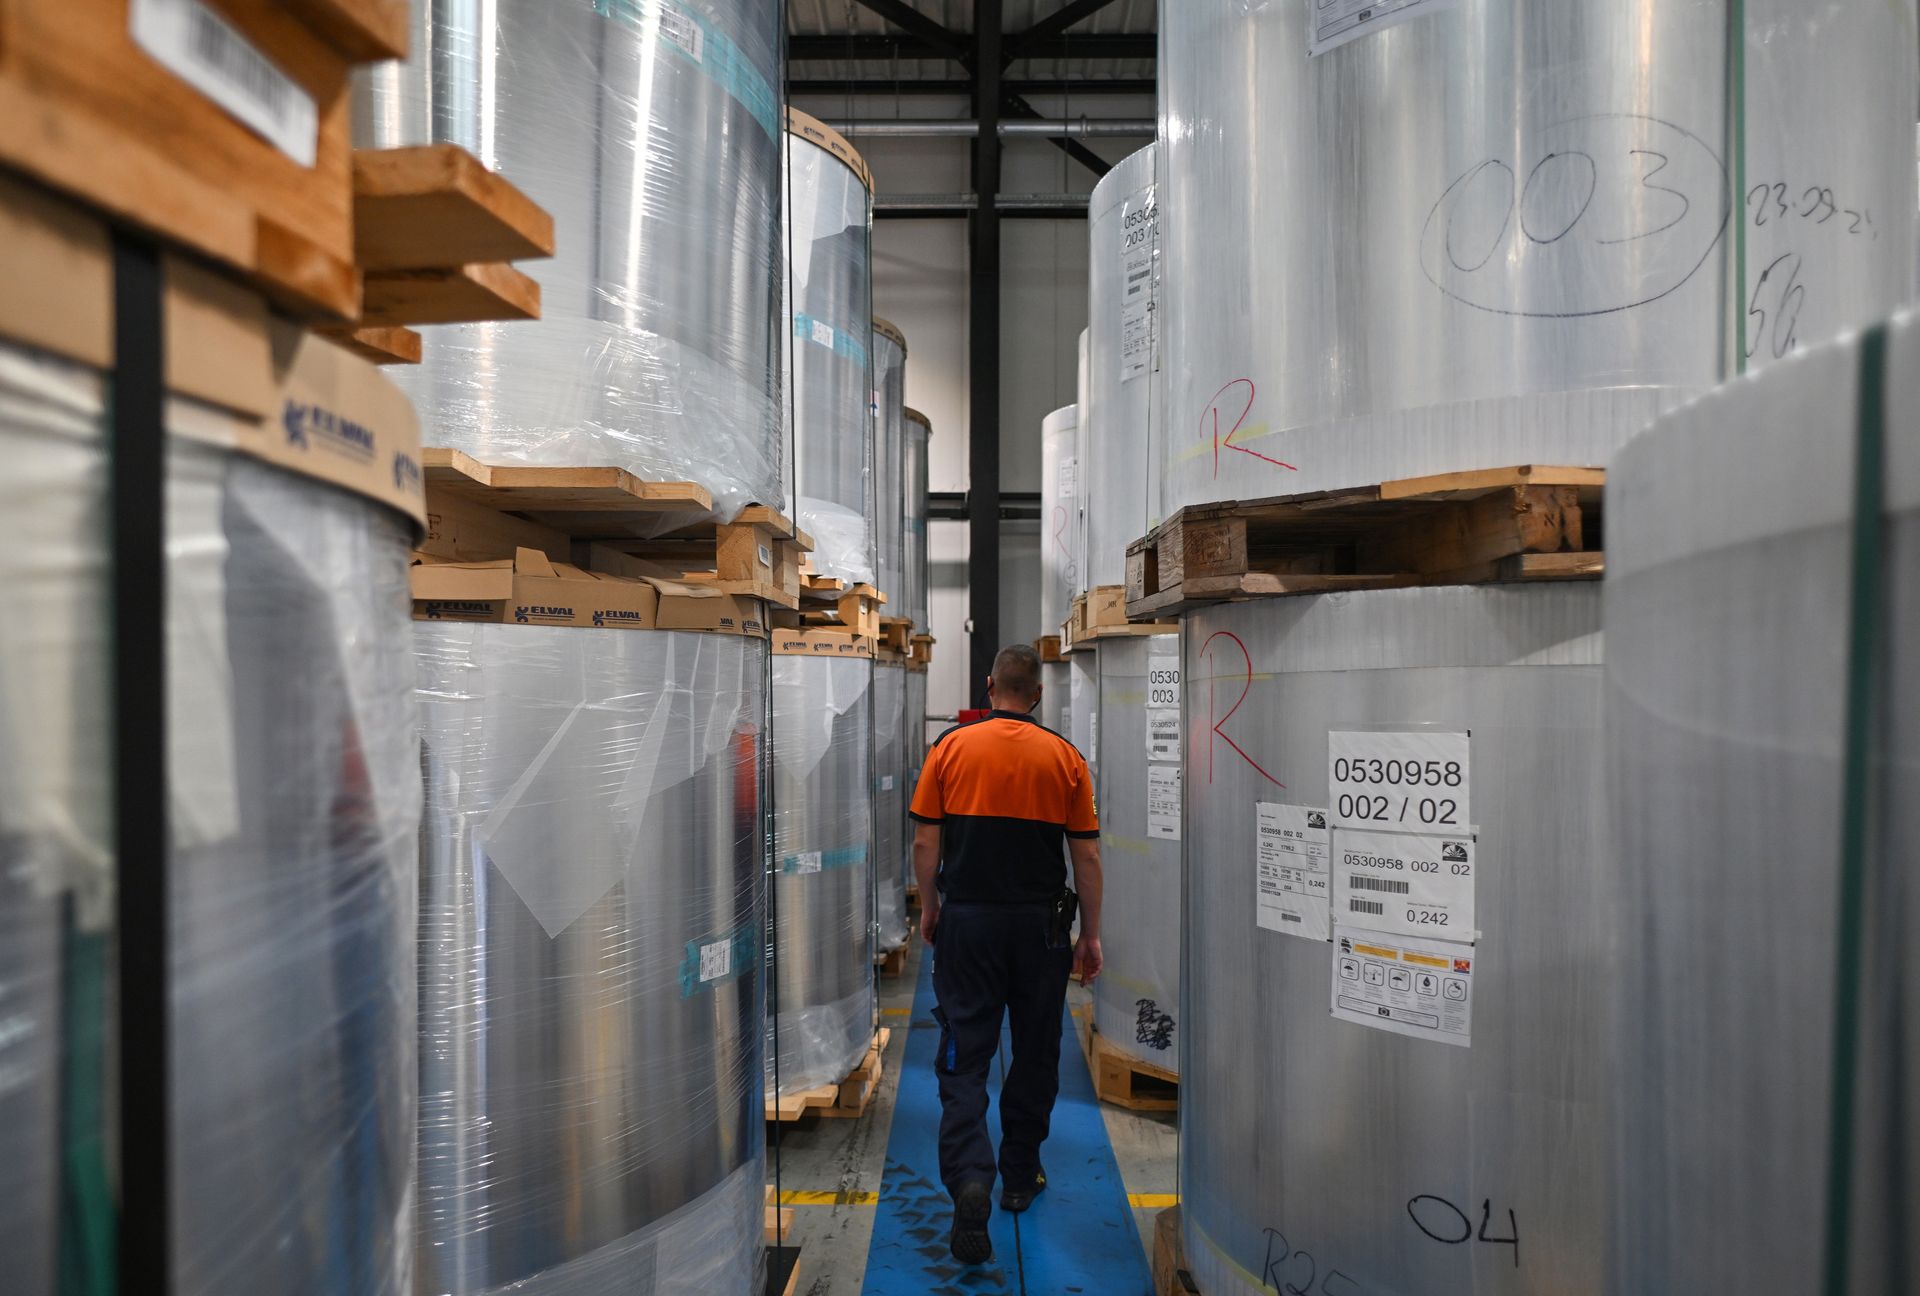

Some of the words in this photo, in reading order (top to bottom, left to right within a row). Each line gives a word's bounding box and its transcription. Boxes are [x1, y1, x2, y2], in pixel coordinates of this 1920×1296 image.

[1446, 150, 1689, 272] 003
[1199, 378, 1298, 481] R
[530, 606, 575, 616] ELVAL
[605, 610, 642, 620] ELVAL
[1152, 689, 1174, 703] 003
[1199, 631, 1287, 789] R
[1335, 757, 1462, 787] 0530958
[1338, 793, 1389, 821] 002
[1398, 796, 1409, 823] /
[1419, 797, 1457, 825] 02
[1260, 826, 1281, 836] 0530958
[1343, 853, 1404, 871] 0530958
[1410, 860, 1439, 874] 002
[1450, 863, 1471, 876] 02
[1308, 879, 1326, 889] 0,242
[1406, 909, 1449, 926] 0,242
[1407, 1194, 1520, 1269] 04
